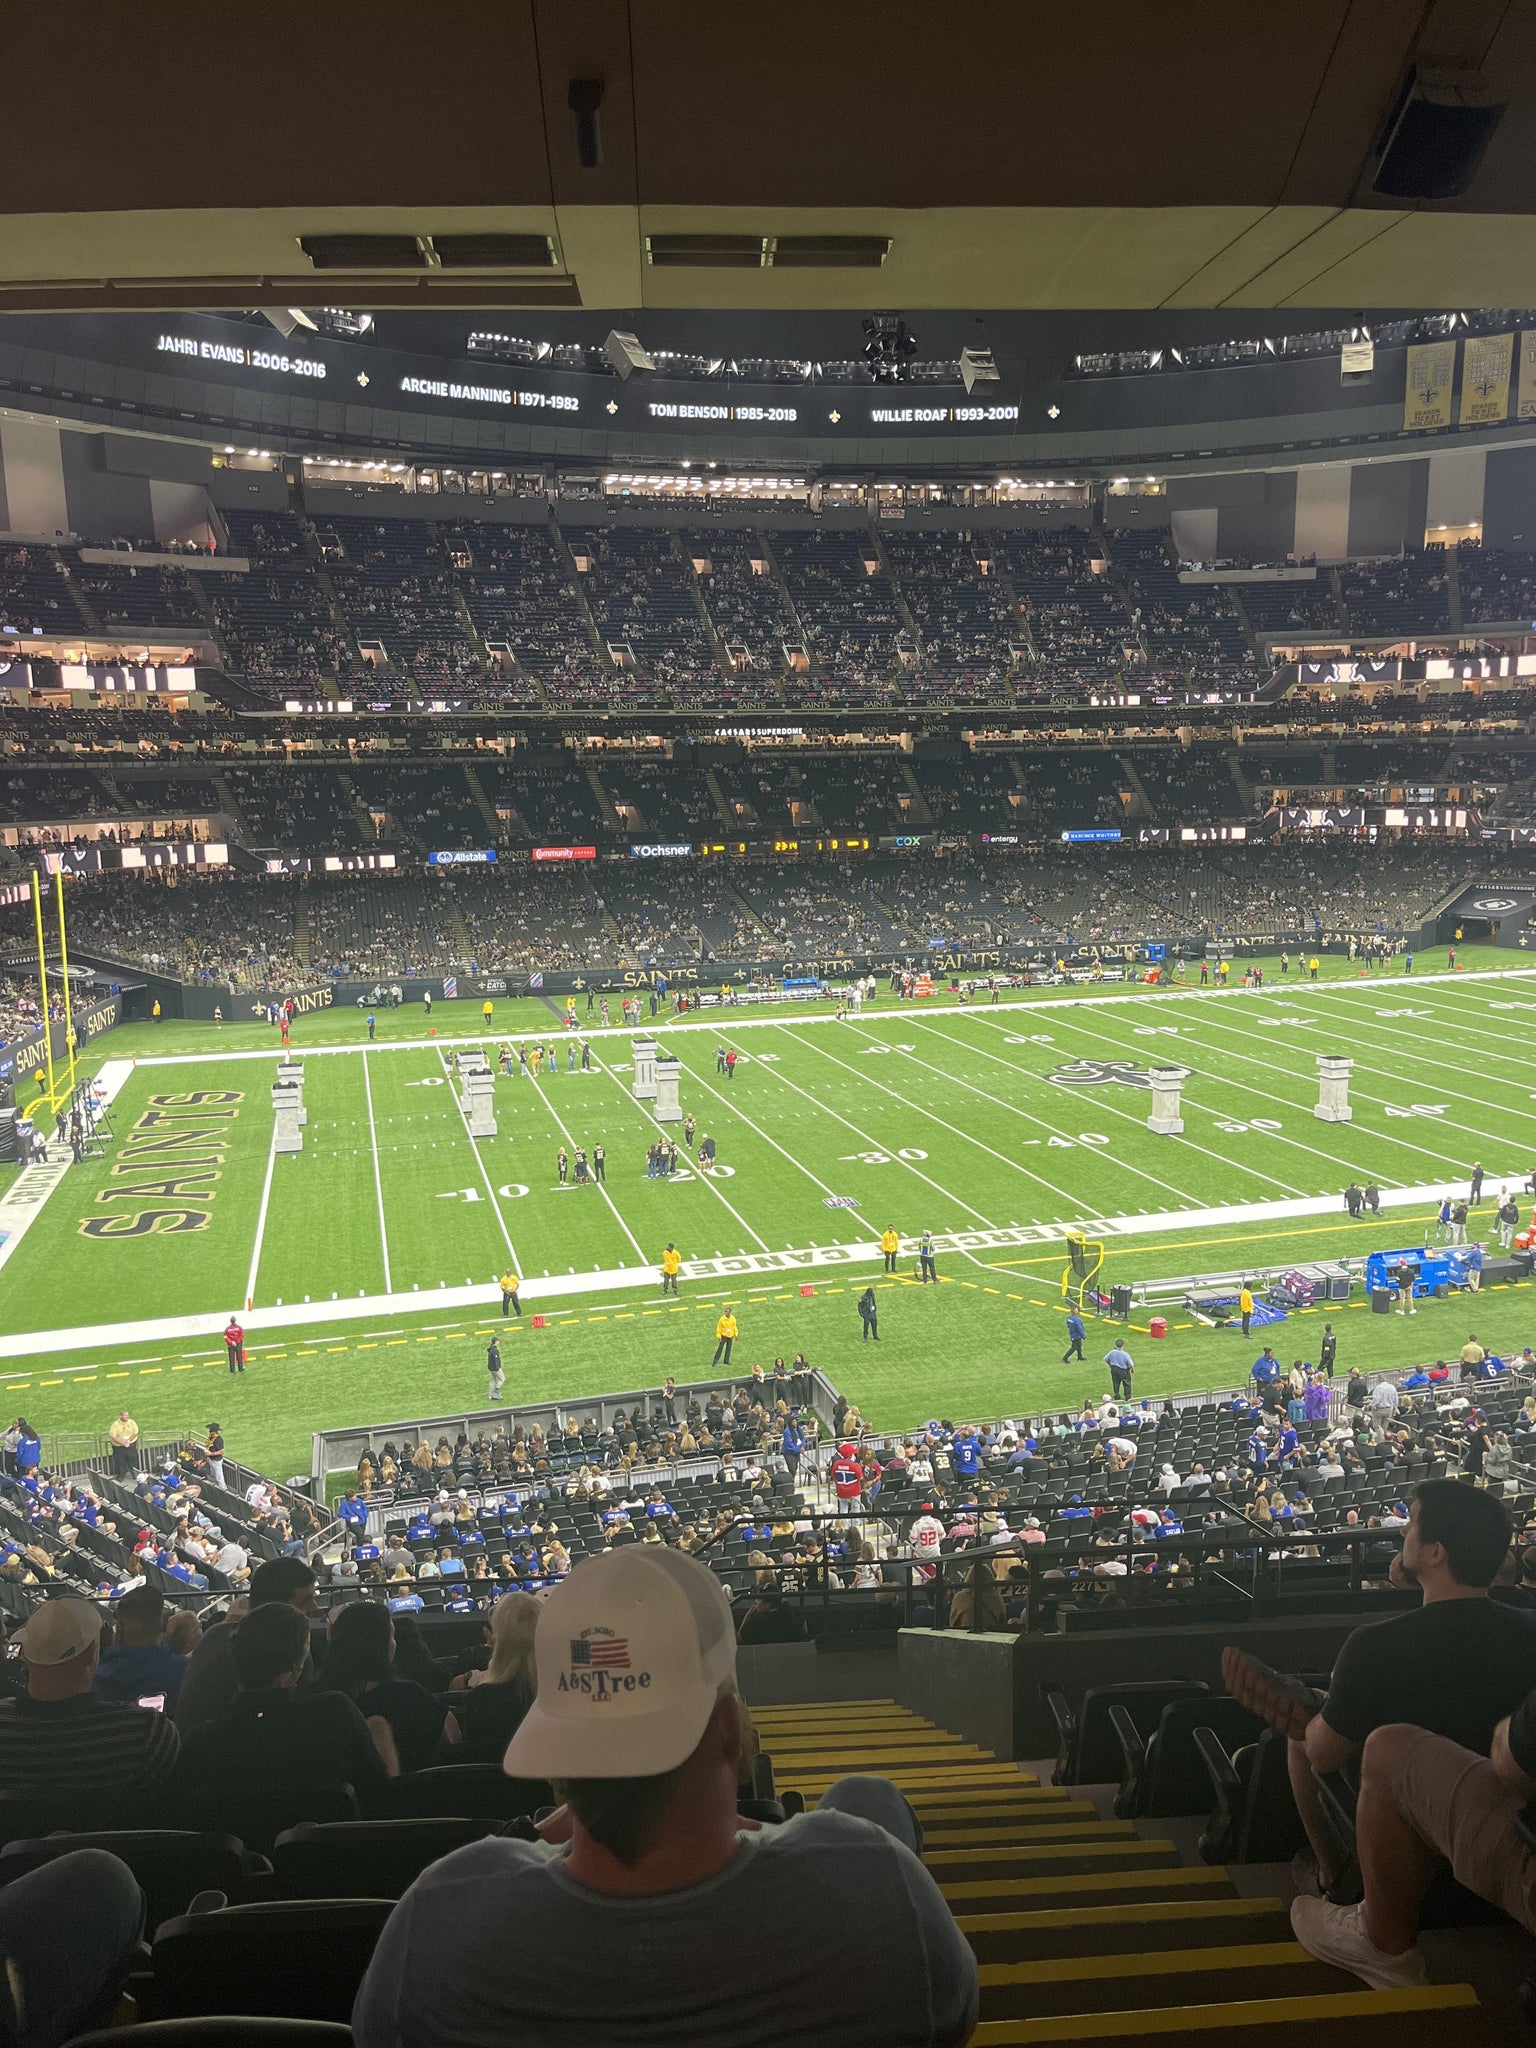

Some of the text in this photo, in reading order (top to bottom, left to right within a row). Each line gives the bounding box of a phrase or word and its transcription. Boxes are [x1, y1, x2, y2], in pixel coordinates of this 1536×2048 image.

[157, 335, 327, 379] JAHRI EVANS 2006-2016
[401, 377, 579, 411] ARCHIE MANNING 1971-1982
[649, 403, 797, 422] TOM BENSON 1985-2018
[872, 406, 1019, 423] WILLIE ROAF 1993-2001
[473, 702, 505, 711] SAINTS
[542, 702, 573, 710] SAINTS
[608, 702, 638, 710] SAINTS
[673, 702, 703, 710] SAINTS
[801, 701, 830, 709] SAINTS
[864, 700, 892, 708] SAINTS
[926, 699, 955, 707] SAINTS
[988, 698, 1016, 706] SAINTS
[1050, 697, 1078, 705] SAINTS
[714, 727, 803, 737] CAESARS SUPERDOME
[895, 837, 921, 847] COX
[990, 835, 1018, 844] entergy
[453, 852, 487, 862] Allstate
[499, 850, 529, 859] SAINTS
[535, 848, 574, 860] Community
[641, 845, 690, 857] Ochsner
[88, 1004, 116, 1036] SAINTS
[1384, 1104, 1445, 1117] 40
[1212, 1118, 1283, 1133] 50
[1047, 1133, 1110, 1148] 40
[856, 1147, 929, 1164] 30
[77, 1090, 245, 1239] SAINTS
[668, 1165, 736, 1182] 20
[457, 1183, 530, 1202] 10
[656, 1221, 1121, 1277] INTERCEP CANCE
[1487, 1364, 1497, 1377] 6
[964, 1450, 971, 1462] 9
[935, 1456, 951, 1469] 32
[919, 1531, 936, 1546] 92
[1014, 1584, 1030, 1595] 22
[1071, 1581, 1093, 1592] 227
